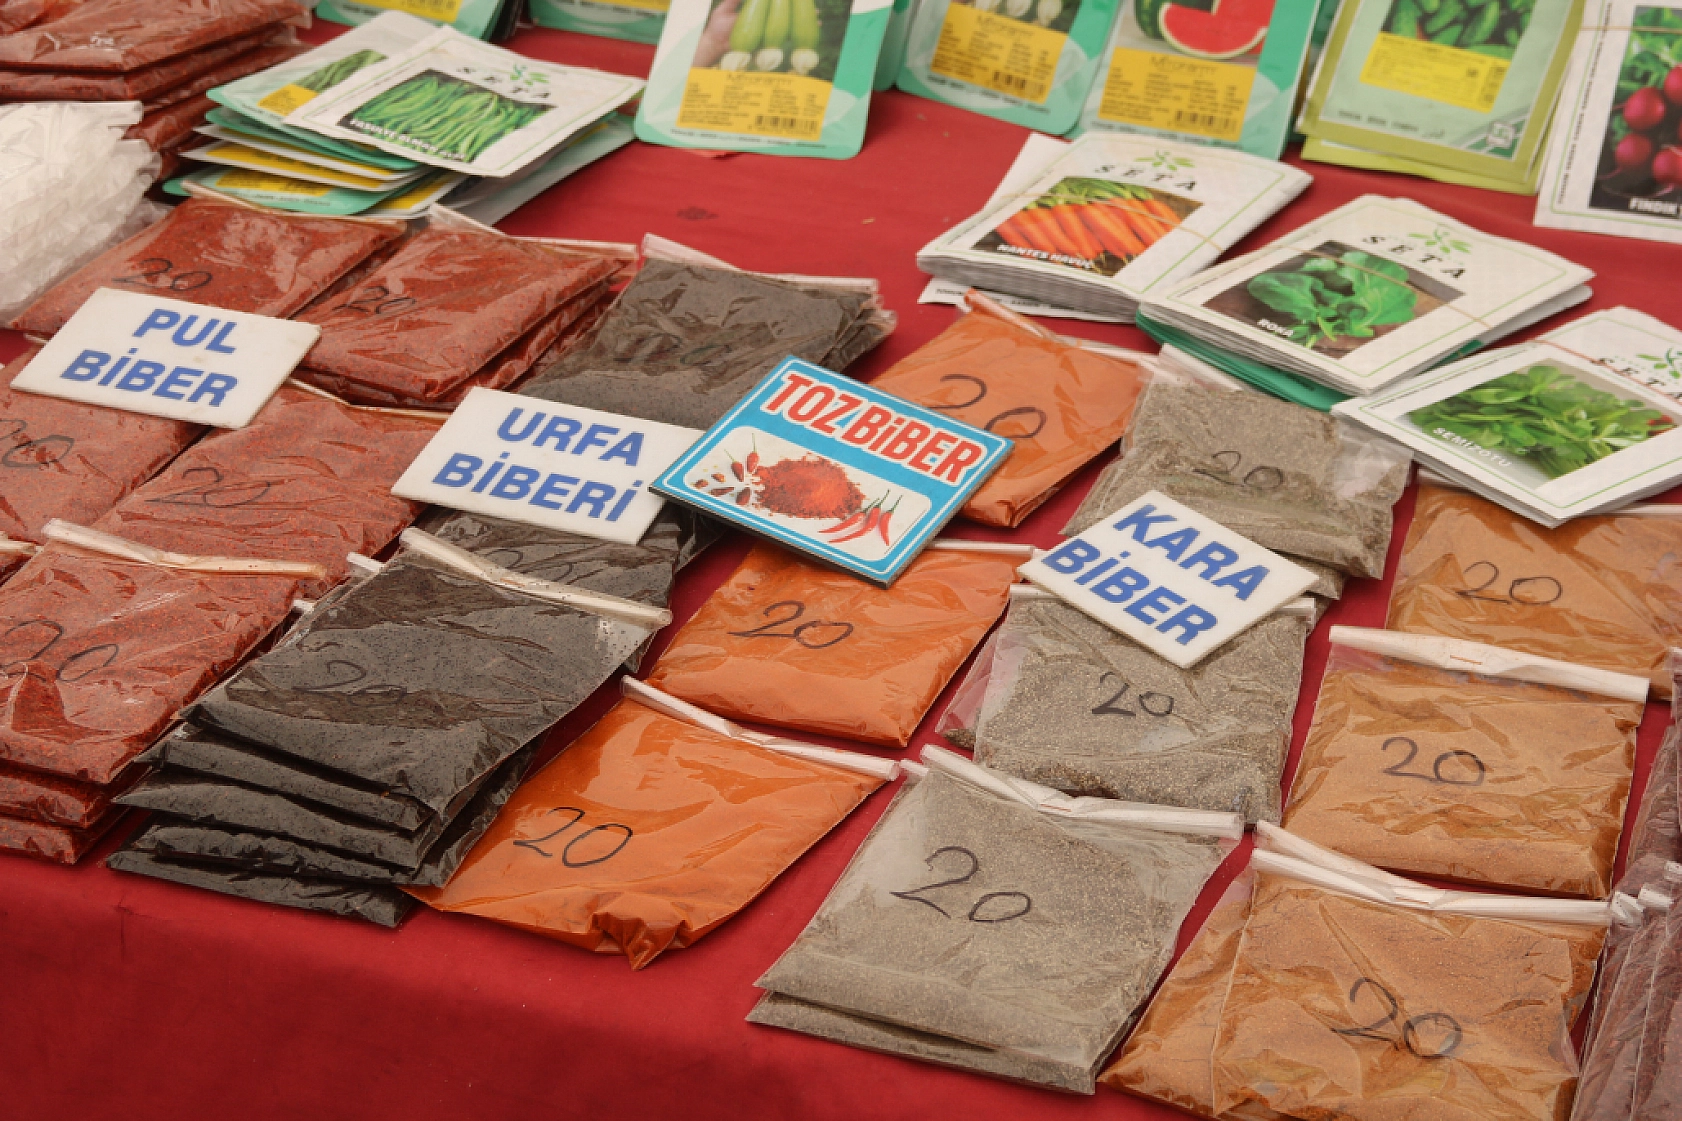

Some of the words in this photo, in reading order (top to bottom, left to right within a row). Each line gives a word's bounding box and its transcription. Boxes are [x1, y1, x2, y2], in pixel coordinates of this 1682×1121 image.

[1093, 164, 1197, 191] SETA
[110, 257, 213, 292] 20
[997, 244, 1049, 260] NANTES
[1361, 235, 1466, 279] SETA
[331, 284, 417, 316] 20
[131, 308, 238, 355] PUL
[1256, 318, 1295, 338] ROKA
[60, 346, 239, 409] BİBER
[762, 371, 865, 437] TOZ
[926, 373, 1048, 439] 20
[496, 406, 646, 468] URFA
[144, 466, 272, 508] 20
[431, 450, 644, 523] BİBERİ
[1194, 450, 1284, 490] 20
[1112, 504, 1271, 602] KARA
[1041, 537, 1219, 647] BİBER
[1456, 561, 1563, 605] 20
[728, 600, 855, 649] 20
[290, 659, 408, 708] 20
[1091, 671, 1175, 718] 20
[1380, 736, 1486, 787] 20
[514, 805, 634, 869] 20
[889, 845, 1033, 923] 20
[1331, 976, 1463, 1060] 20
